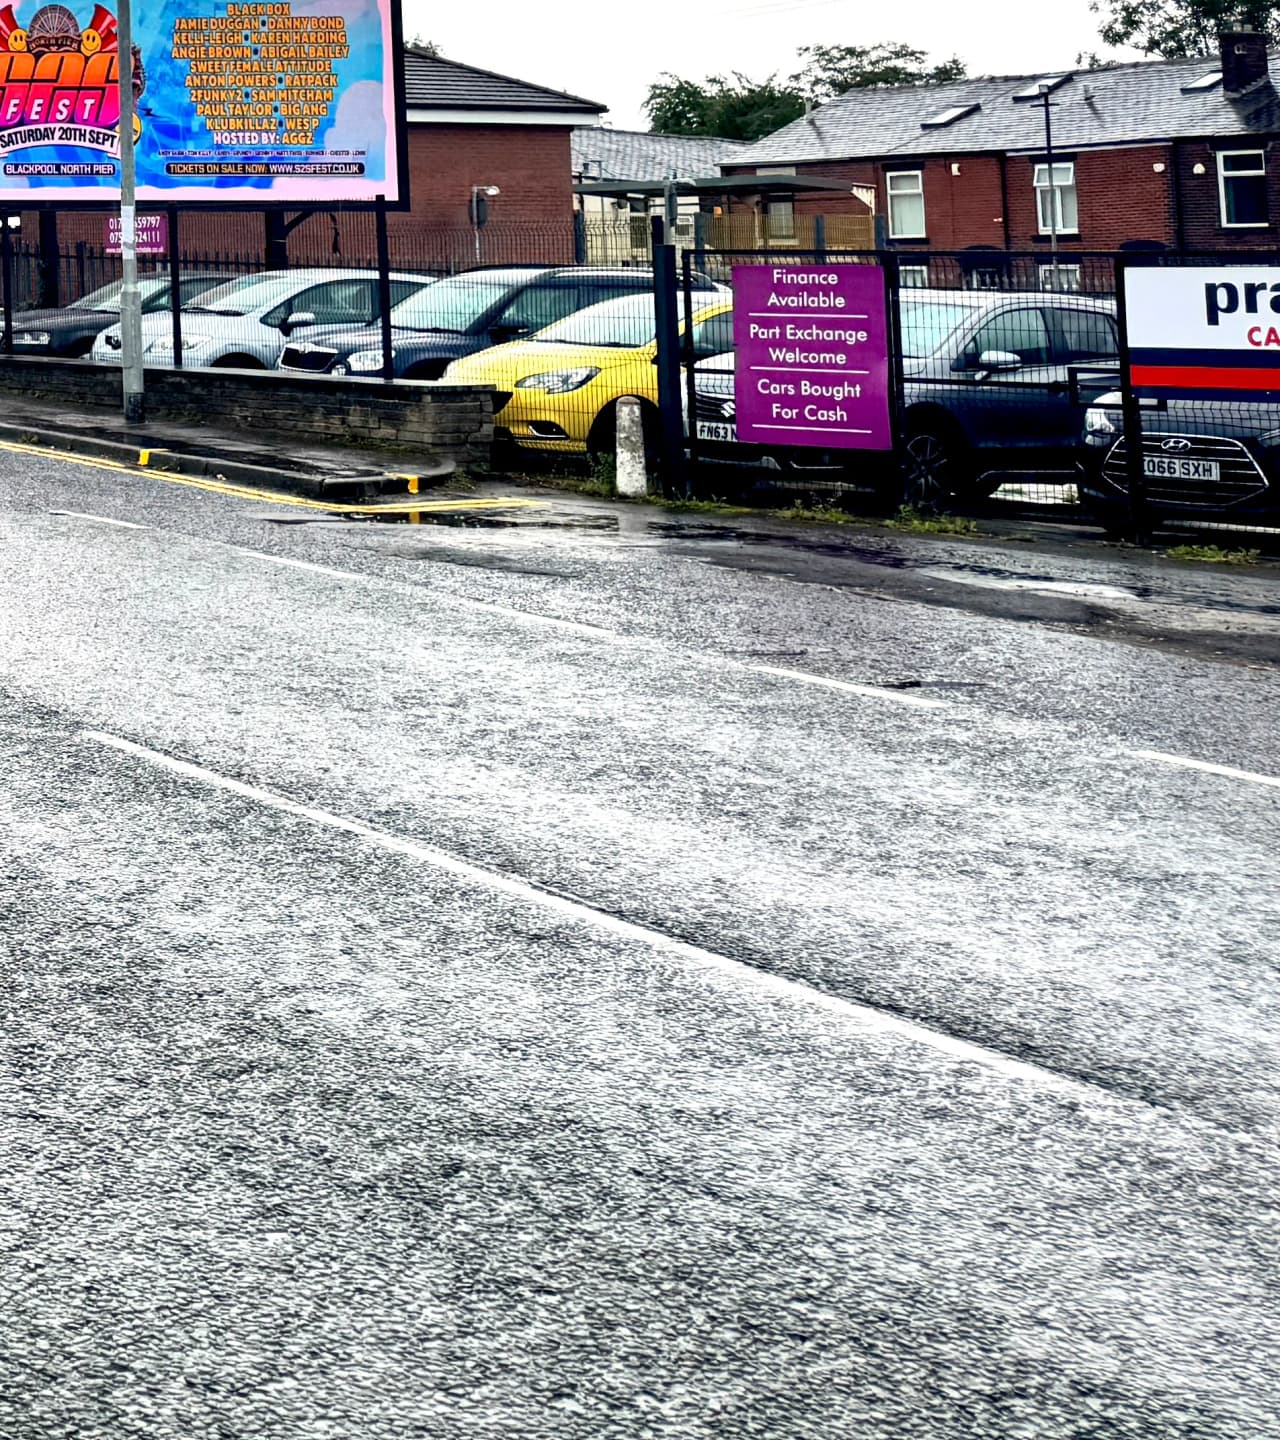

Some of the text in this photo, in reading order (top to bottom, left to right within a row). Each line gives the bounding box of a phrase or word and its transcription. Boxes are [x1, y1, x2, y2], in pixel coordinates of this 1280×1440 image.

[226, 3, 290, 16] BLACK BOX
[175, 17, 344, 30] JAMIE DUGGAN DANNY BOND
[173, 31, 347, 44] KELLI-LEIGH KAREN HARDING
[171, 45, 350, 58] ANGIE BROWN ABIGAIL BAILEY
[190, 60, 332, 73] SWEET FEMALE ATTITUDE
[185, 75, 338, 87] ANTON POWERS RATPACK
[190, 89, 333, 102] 2FUNKY2 SAM MITCHAM
[5, 98, 98, 121] FEST
[196, 103, 328, 116] PAUL TAYLOR BIG ANG
[206, 117, 320, 130] KLUBKILLAZ WES P
[0, 126, 118, 149] SATURDAY 20TH SEPT
[213, 132, 313, 145] HOSTED BY: AGGZ
[5, 164, 114, 175] BLACKPOOL NORTH PIER
[170, 163, 205, 174] TICKETS
[206, 163, 220, 174] ON
[221, 163, 244, 174] SALE
[773, 269, 838, 285] Finance
[767, 291, 846, 308] Available
[749, 323, 868, 345] Part Exchange
[768, 347, 847, 365] Welcome
[757, 378, 862, 401] Cars Bought
[772, 403, 848, 422] For Cash
[699, 424, 728, 439] FN63
[1143, 458, 1213, 478] O66 SXH
